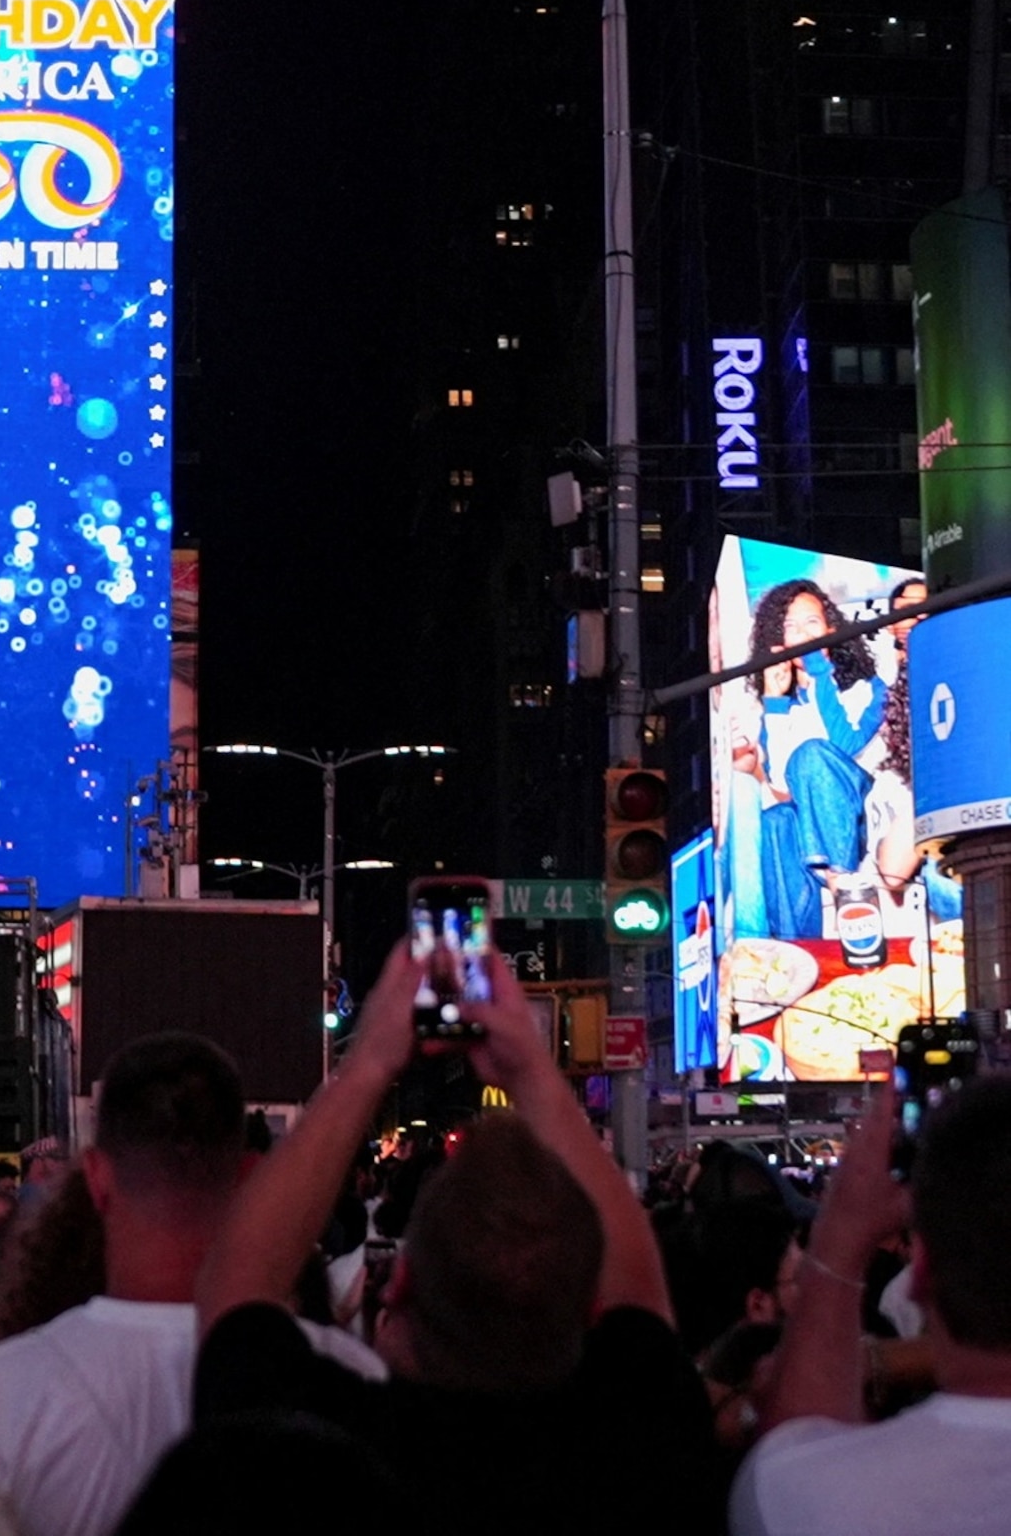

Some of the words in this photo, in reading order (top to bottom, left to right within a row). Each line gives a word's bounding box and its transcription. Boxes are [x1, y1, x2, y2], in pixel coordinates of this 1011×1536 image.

[31, 241, 119, 270] TIME
[960, 804, 1003, 825] CHASE
[509, 885, 530, 913] W
[543, 885, 573, 913] 44
